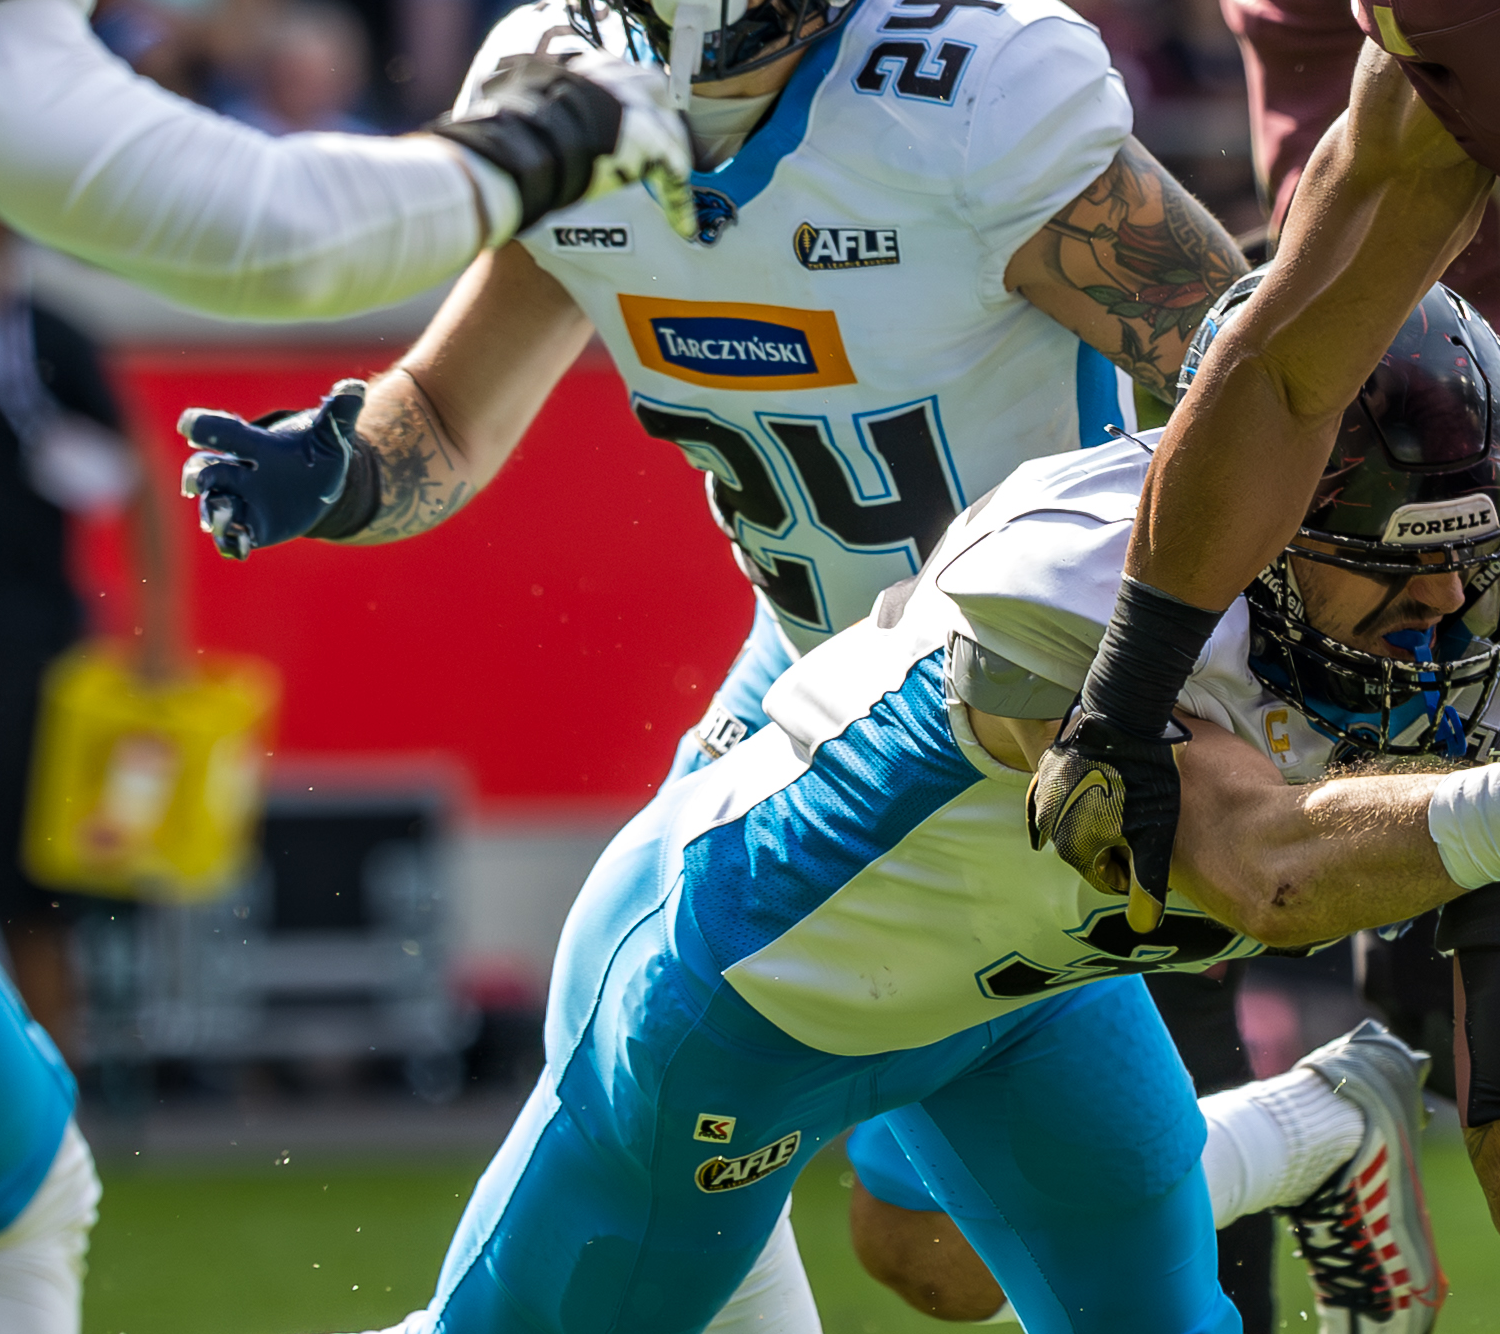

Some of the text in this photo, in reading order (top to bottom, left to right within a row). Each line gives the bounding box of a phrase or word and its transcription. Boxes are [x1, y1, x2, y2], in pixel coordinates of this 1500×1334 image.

[808, 229, 897, 263] AFLE
[631, 392, 968, 634] 24
[1397, 509, 1492, 538] FORELLE
[711, 1136, 796, 1186] AFLE
